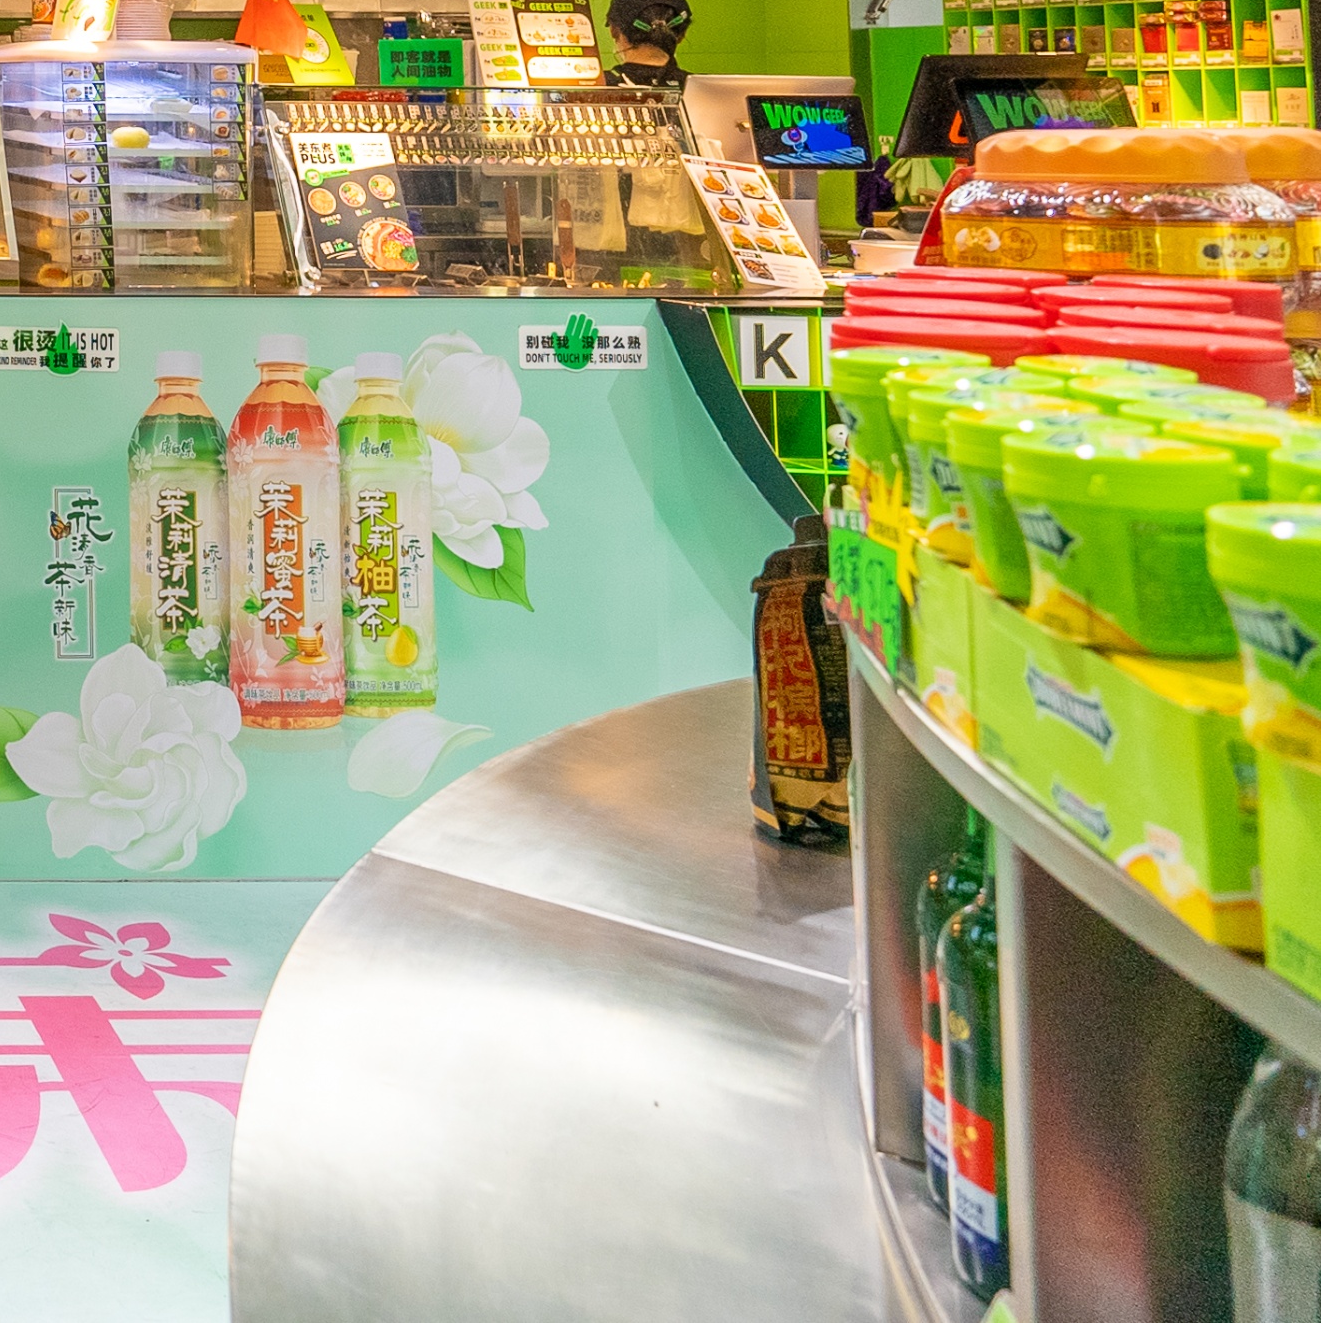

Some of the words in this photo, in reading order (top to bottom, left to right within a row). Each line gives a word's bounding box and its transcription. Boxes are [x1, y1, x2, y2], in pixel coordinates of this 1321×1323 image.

[473, 0, 498, 10] GEEK
[479, 43, 503, 52] GEEK
[389, 49, 452, 65] 即客就是
[761, 100, 823, 130] WOW
[300, 153, 336, 165] PLUS
[76, 332, 87, 351] IS
[90, 333, 115, 351] HOT
[525, 335, 569, 350] 别碰我
[581, 335, 642, 350] 没那么熟
[525, 353, 550, 363] DON'T
[551, 353, 580, 364] TOUCH
[599, 353, 642, 364] SERIOUSLY
[754, 322, 798, 380] K
[151, 488, 203, 634] 茉莉清茶
[254, 480, 309, 639] 茉莉蜜茶
[350, 488, 404, 642] 茉莉柚茶
